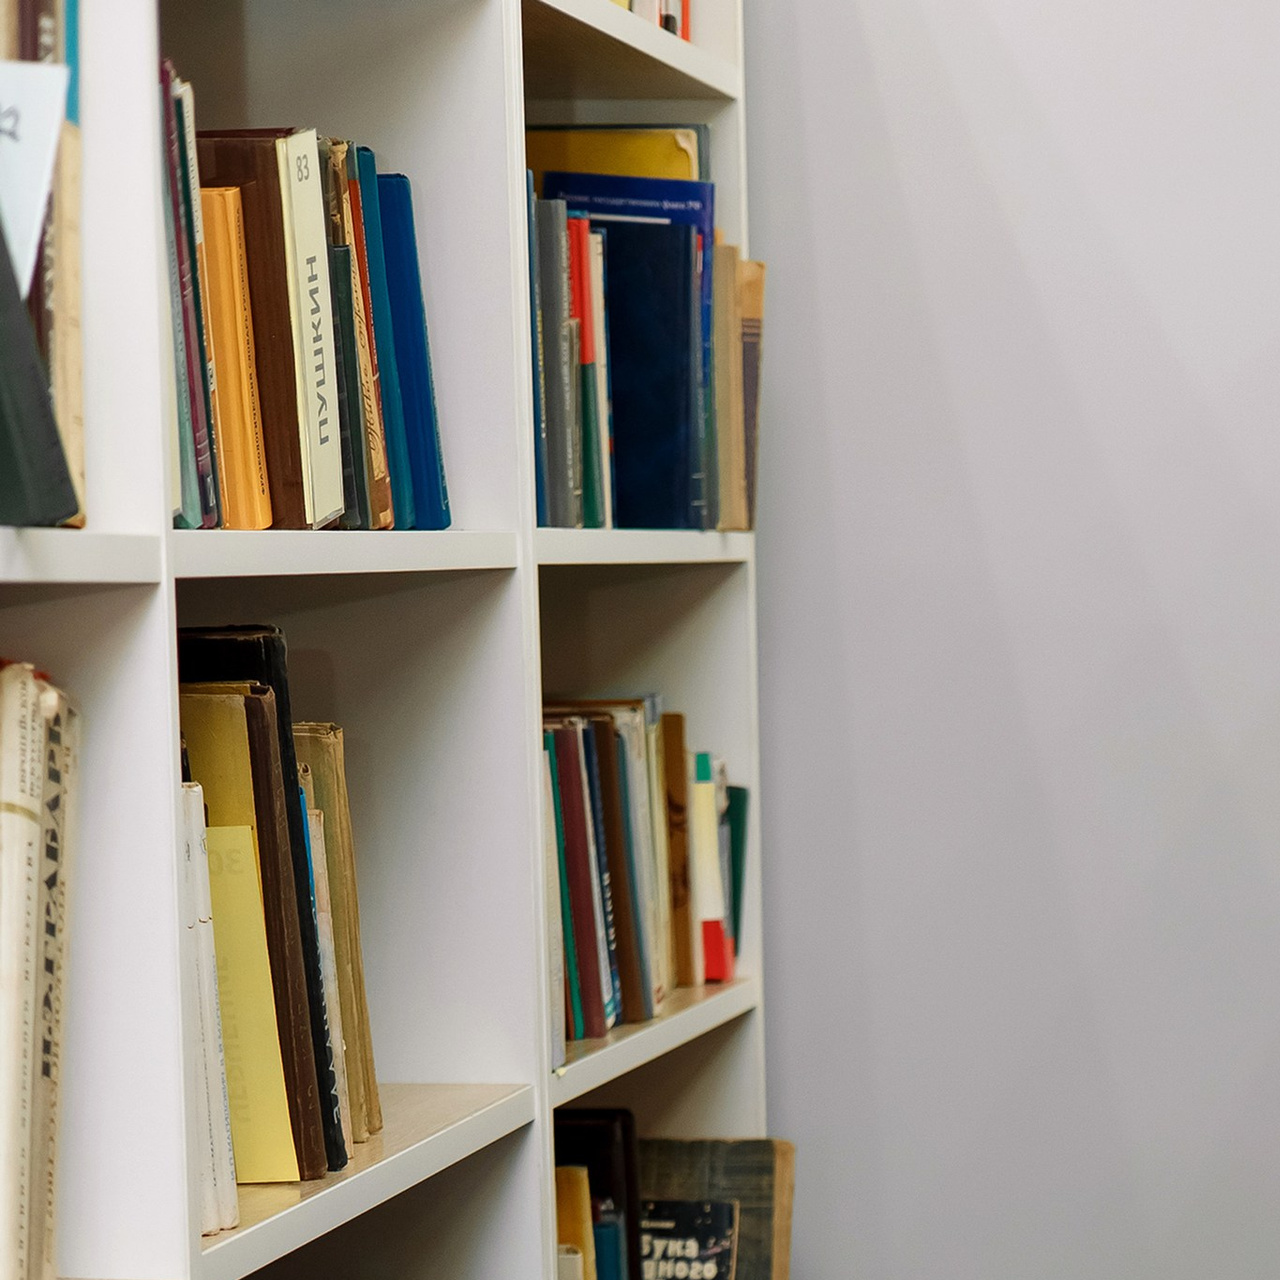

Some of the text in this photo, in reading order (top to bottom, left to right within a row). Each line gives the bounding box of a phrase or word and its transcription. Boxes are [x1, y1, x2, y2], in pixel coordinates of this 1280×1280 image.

[296, 154, 311, 183] 83
[239, 253, 247, 312] РУССКОГО
[244, 314, 252, 369] СЛОВАРЬ
[305, 254, 330, 447] ПУШКИН
[248, 372, 266, 496] ФРАЗЕОЛОГИЧЕСКИЙ
